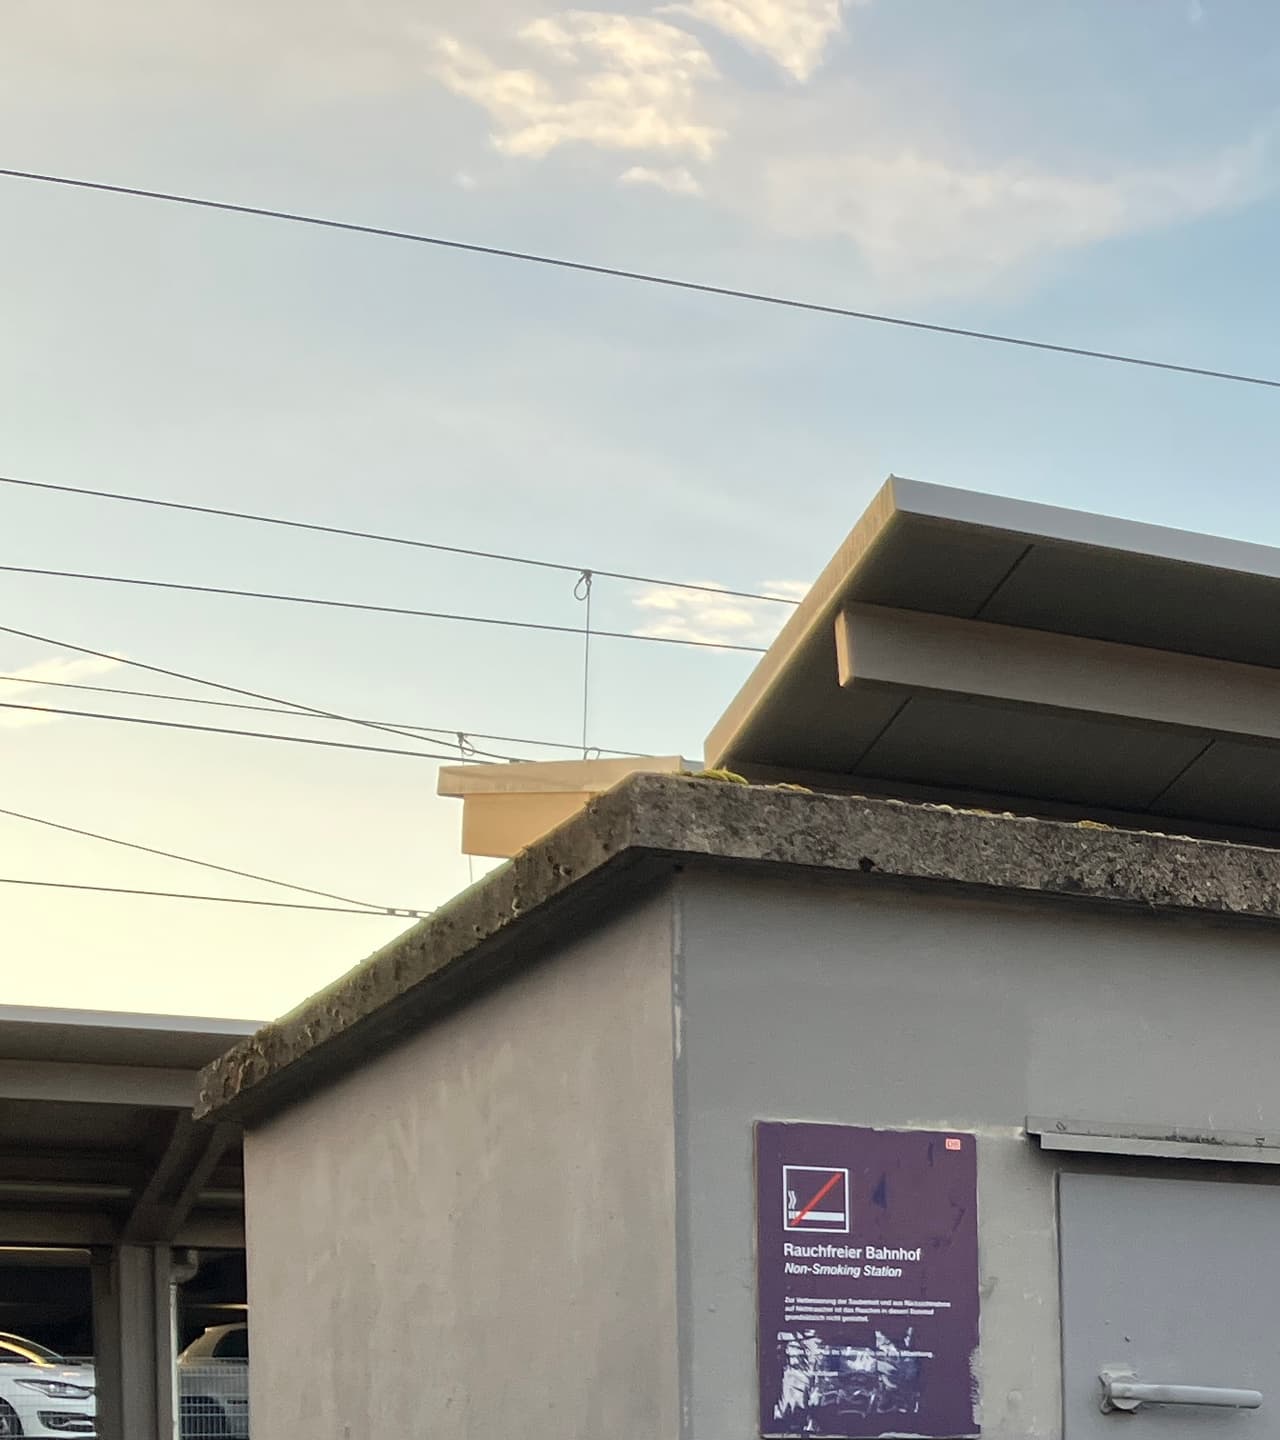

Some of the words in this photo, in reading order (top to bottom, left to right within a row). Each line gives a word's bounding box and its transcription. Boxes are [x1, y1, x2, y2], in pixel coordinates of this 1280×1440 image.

[783, 1243, 862, 1259] Rauchfreier
[865, 1246, 921, 1261] Bahnhof
[784, 1262, 861, 1279] Non-Smoking
[863, 1264, 903, 1278] Station
